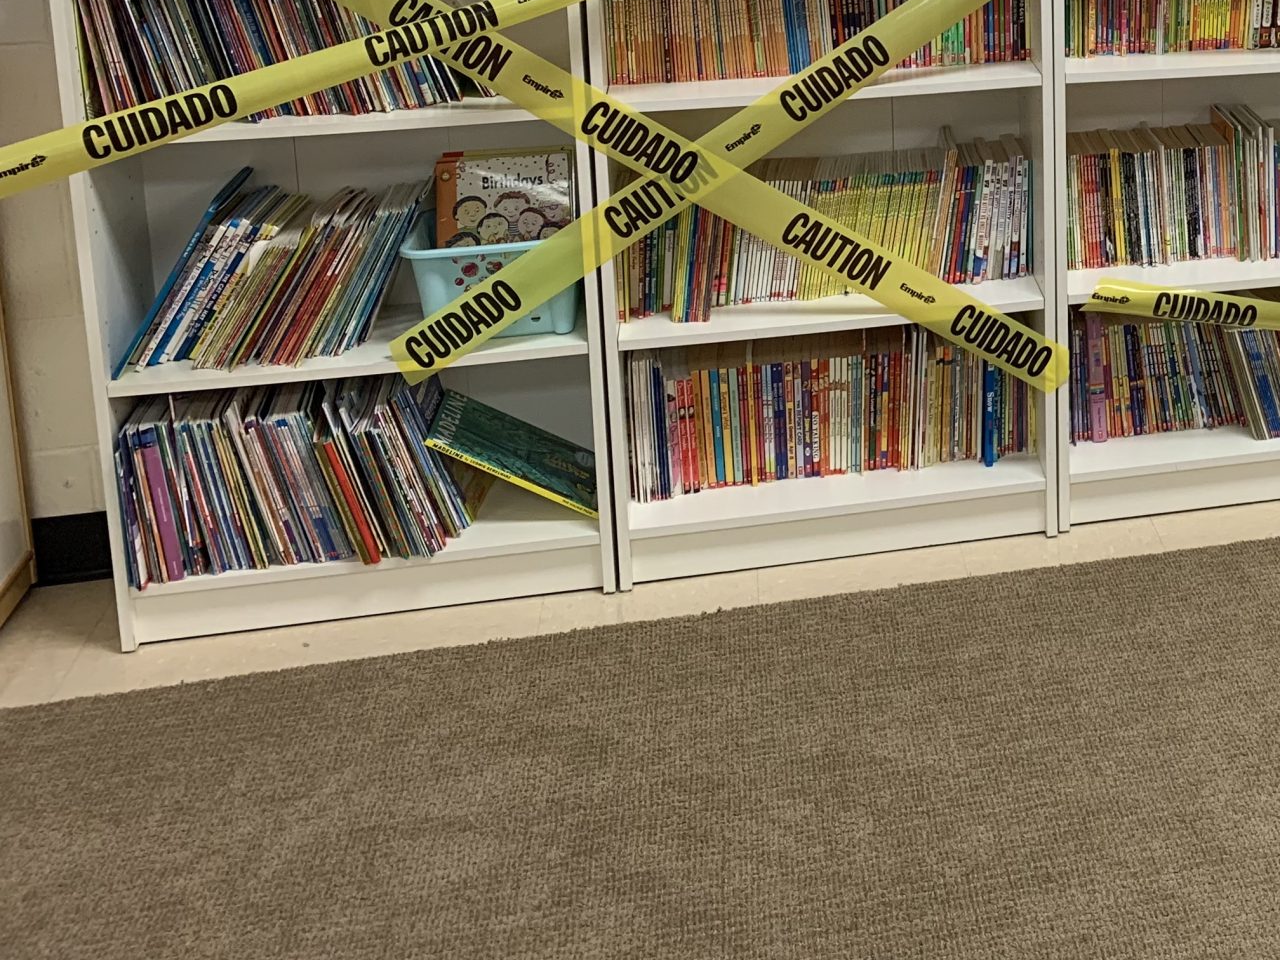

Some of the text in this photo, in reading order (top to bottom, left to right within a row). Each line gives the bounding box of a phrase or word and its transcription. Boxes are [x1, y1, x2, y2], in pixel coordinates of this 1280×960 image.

[364, 0, 499, 66] CAUTION
[82, 84, 238, 160] CUIDADO
[481, 171, 544, 190] Birthdays
[781, 212, 892, 291] CAUTION
[1152, 292, 1257, 327] CUIDADO
[432, 443, 464, 460] MADELINE
